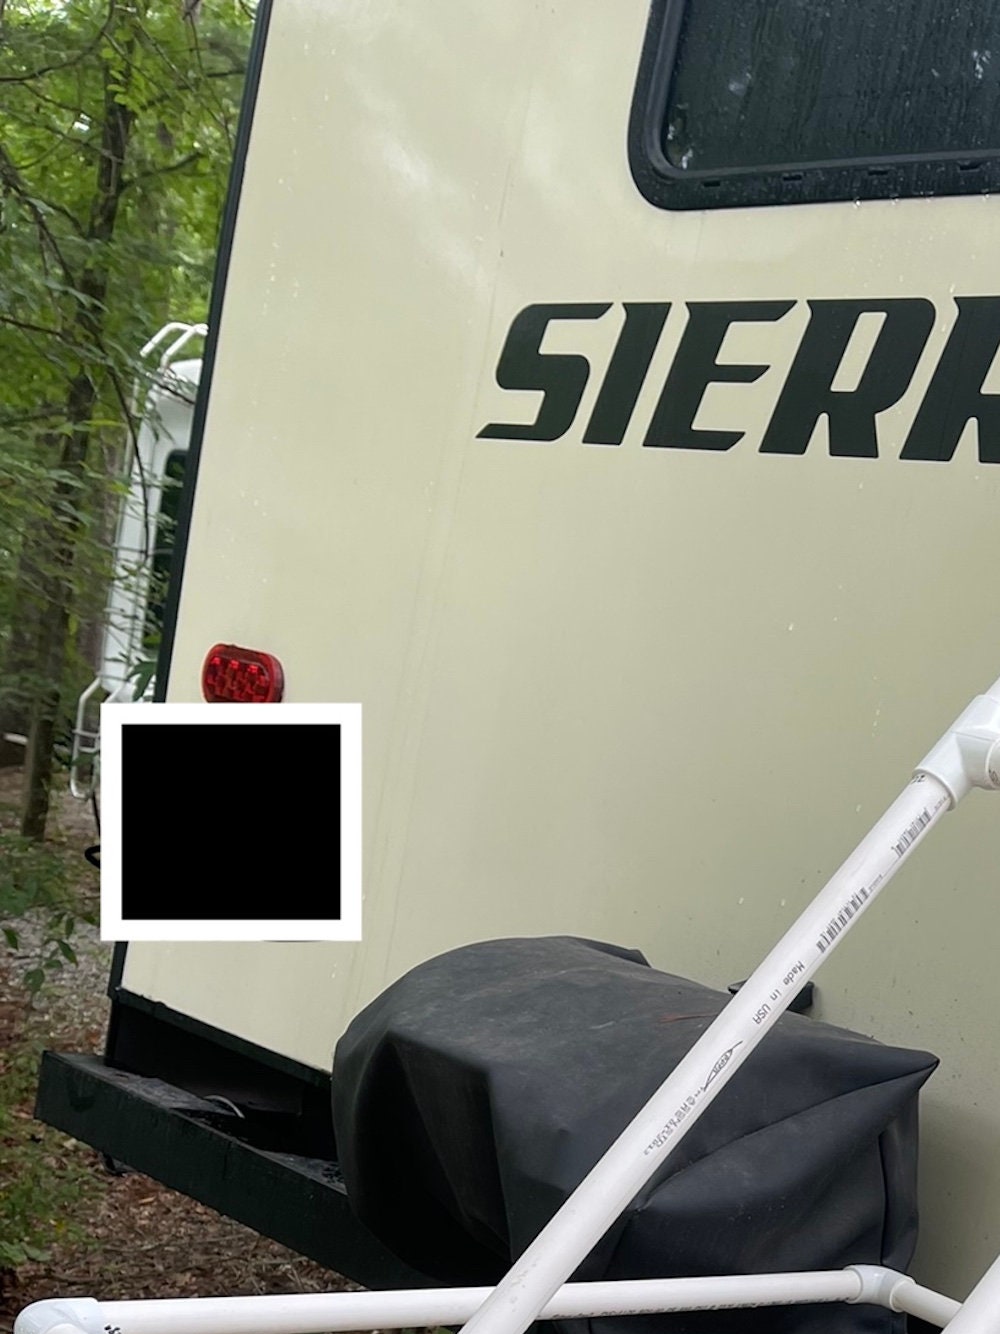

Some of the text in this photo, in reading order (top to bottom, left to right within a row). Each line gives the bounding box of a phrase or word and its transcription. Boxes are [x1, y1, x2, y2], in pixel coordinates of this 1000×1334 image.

[750, 959, 806, 1025] Made in USA
